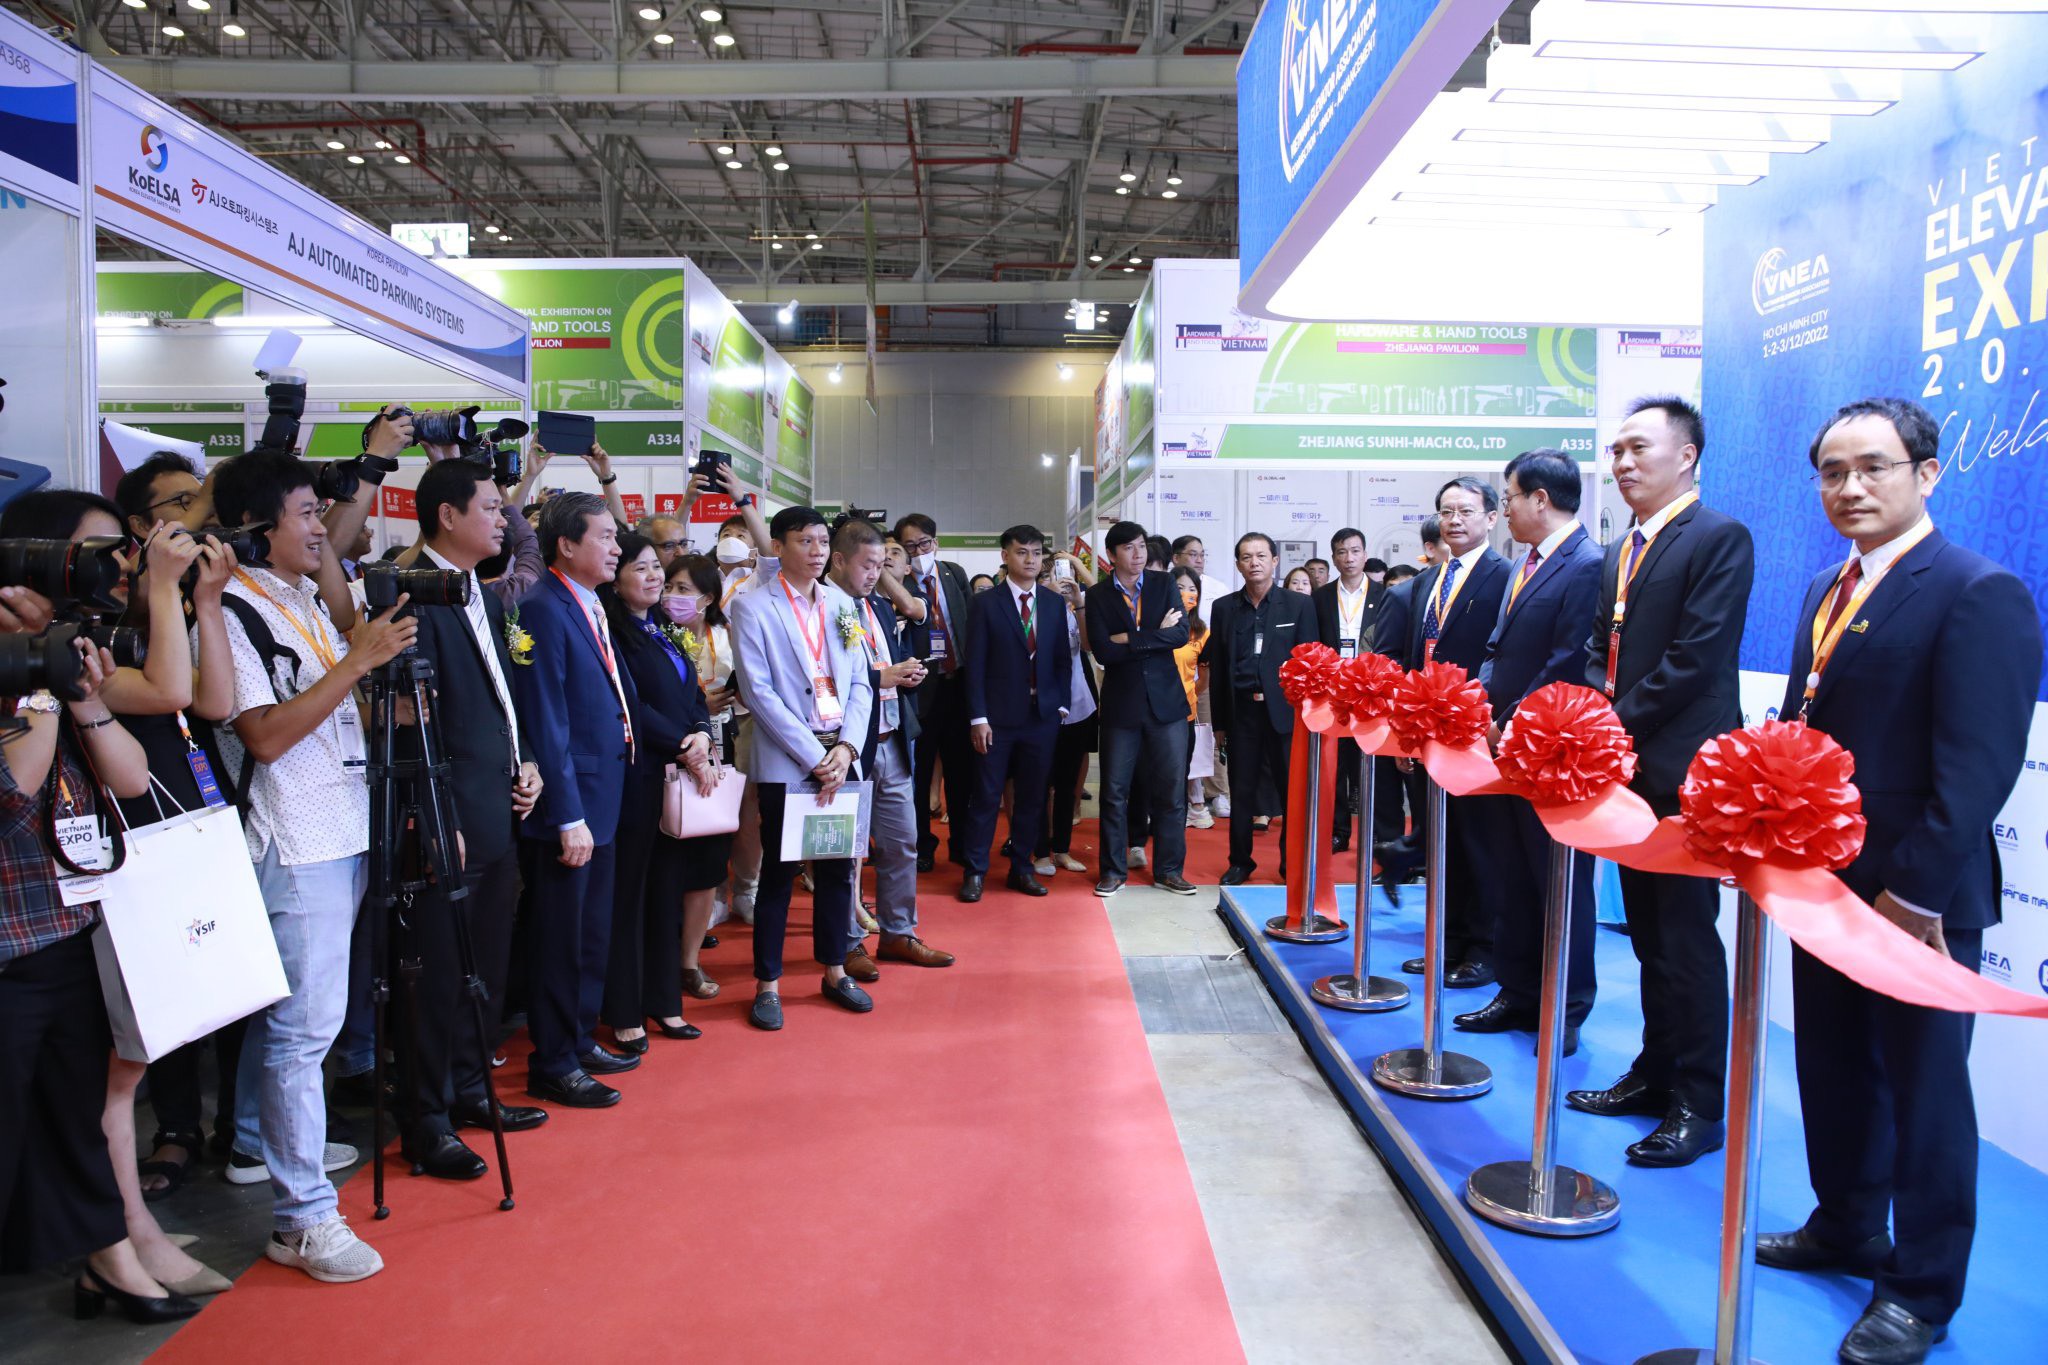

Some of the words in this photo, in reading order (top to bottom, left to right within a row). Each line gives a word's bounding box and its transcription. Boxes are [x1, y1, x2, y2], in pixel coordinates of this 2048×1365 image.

[1291, 0, 1361, 117] VNE
[129, 165, 181, 207] KoELSA
[408, 228, 450, 243] EXIT
[366, 247, 385, 264] KOREA
[1763, 253, 1829, 296] VNEA
[288, 232, 304, 257] AJ
[308, 242, 379, 293] AUTOMATED
[382, 278, 423, 315] PARKING
[425, 301, 465, 335] SYSTEMS
[541, 308, 595, 316] EXHIBITION
[597, 308, 612, 316] ON
[563, 320, 612, 334] TOOLS
[1763, 328, 1775, 340] HO
[1775, 322, 1788, 336] CHI
[1789, 315, 1810, 331] MINH
[1811, 308, 1829, 325] CITY
[1335, 324, 1420, 338] HARDWARE
[1422, 326, 1432, 338] &
[1436, 326, 1476, 338] HAND
[1480, 327, 1527, 339] TOOLS
[531, 338, 562, 348] VILION
[1222, 339, 1267, 349] VIETNAM
[1385, 343, 1434, 353] ZHEJIANG
[1436, 344, 1479, 353] PAVILION
[1763, 325, 1829, 358] 1-2-3/12/2022
[209, 435, 241, 447] A333
[647, 433, 682, 446] A334
[1298, 436, 1364, 448] ZHEJIANG
[1367, 436, 1451, 449] SUNHI-MACH
[1455, 436, 1480, 450] CO.,
[1483, 437, 1506, 449] LTD
[1560, 438, 1593, 451] A335
[56, 824, 92, 834] VIETNAM
[58, 832, 92, 846] EXPO
